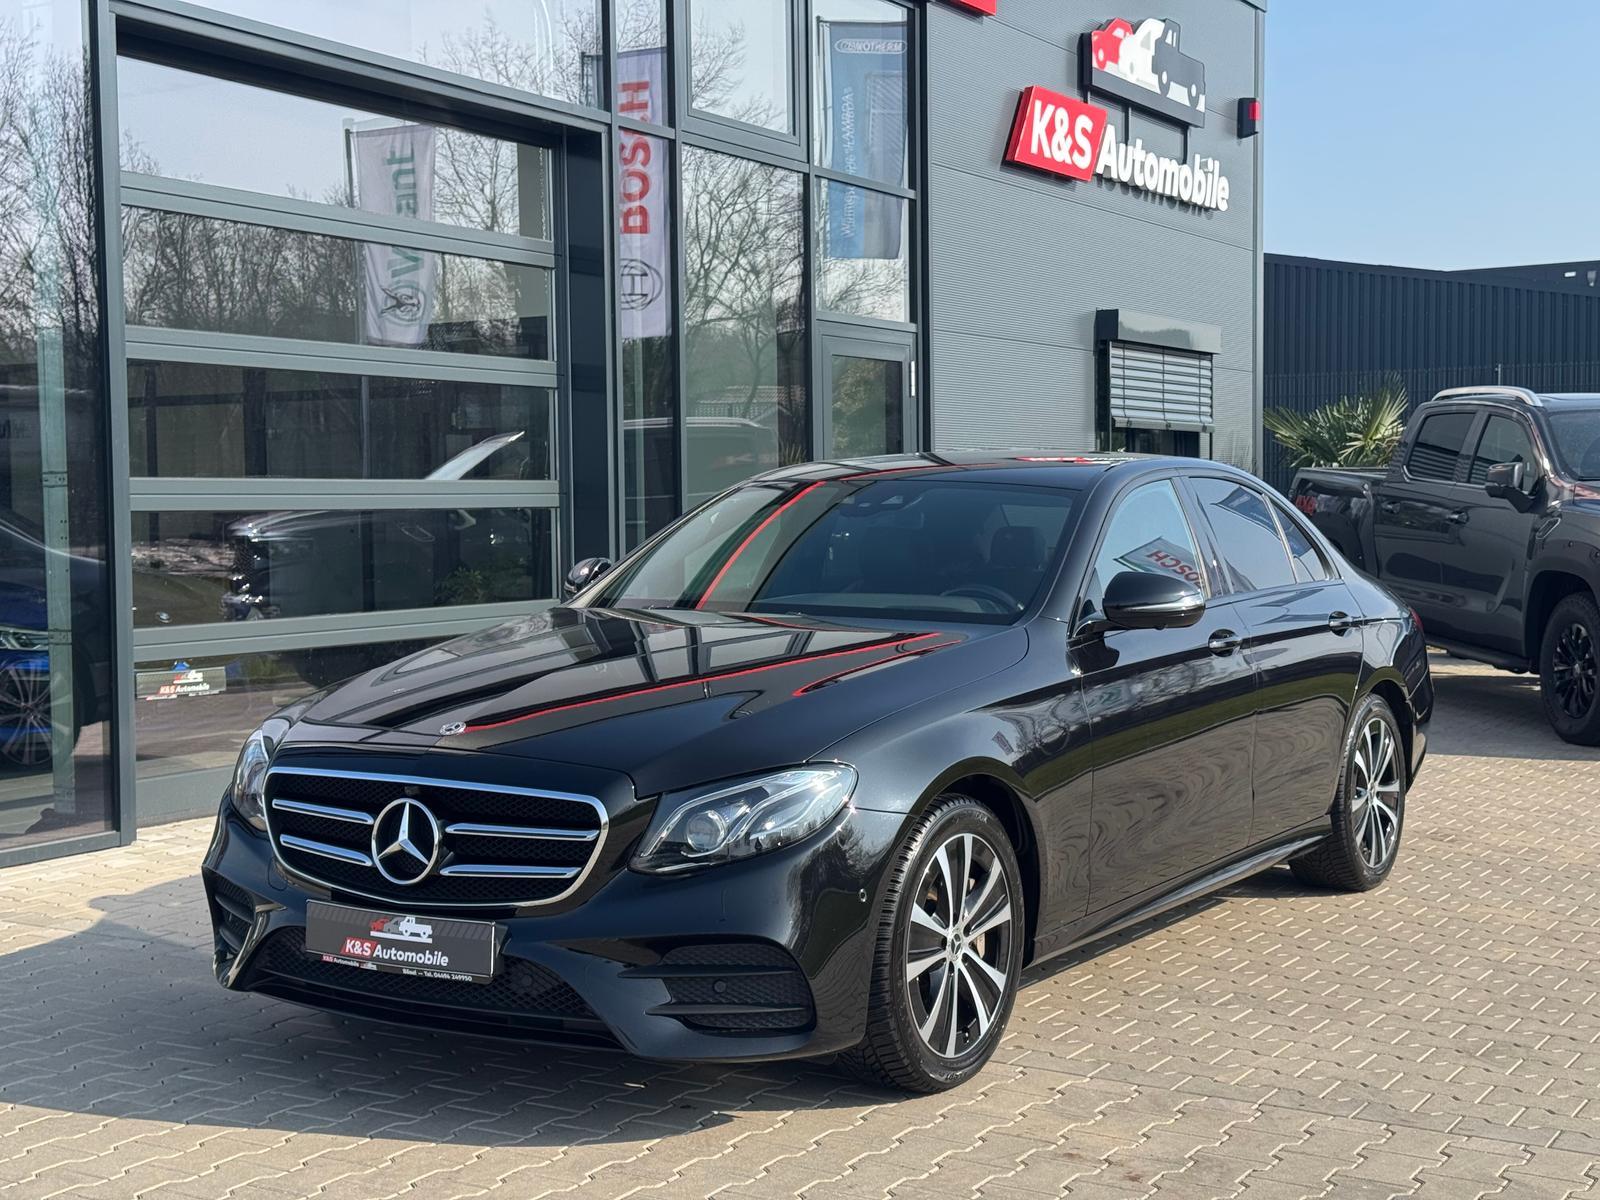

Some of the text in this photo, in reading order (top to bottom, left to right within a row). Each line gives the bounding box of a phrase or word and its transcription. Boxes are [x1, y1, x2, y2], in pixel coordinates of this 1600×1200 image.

[619, 80, 652, 235] BOSH
[1029, 98, 1230, 212] K&S Automobile
[345, 939, 449, 967] K&S Automobile
